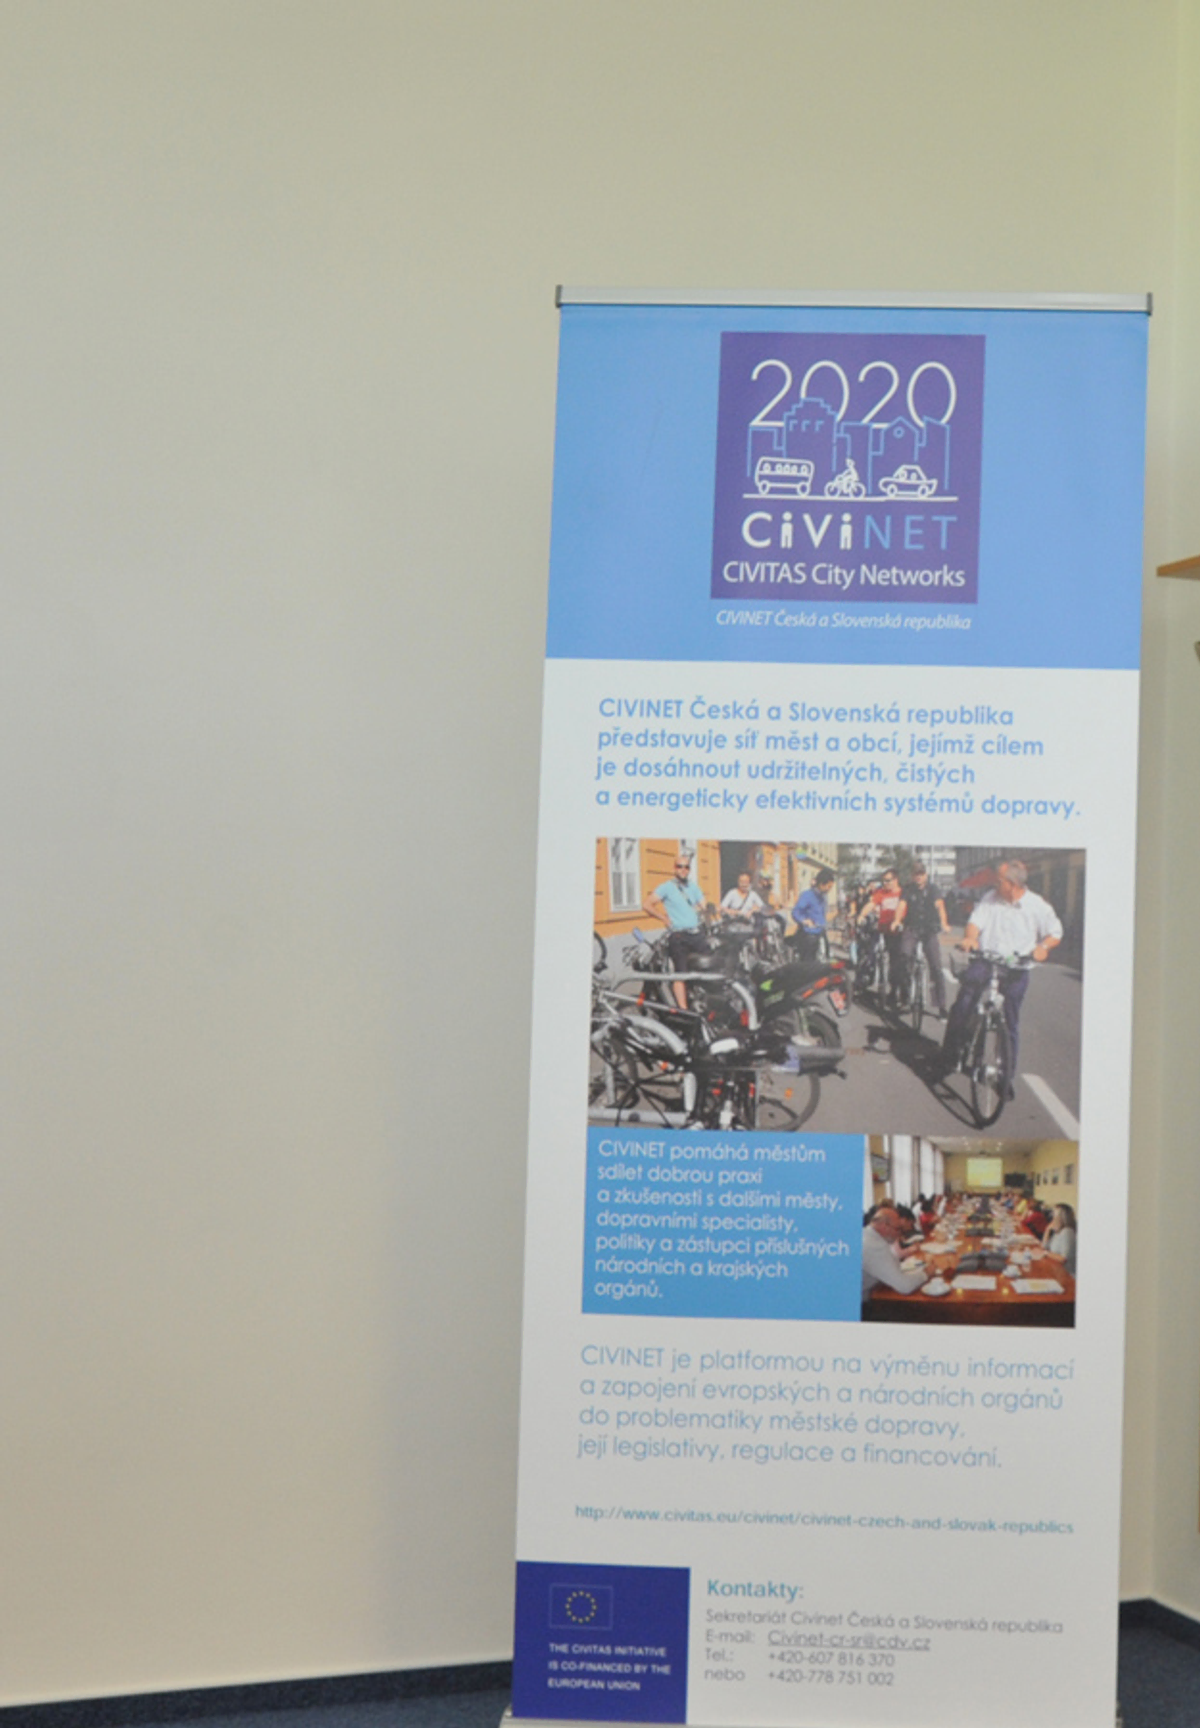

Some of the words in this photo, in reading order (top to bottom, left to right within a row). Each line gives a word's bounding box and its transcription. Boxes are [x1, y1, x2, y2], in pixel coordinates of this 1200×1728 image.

[751, 359, 956, 428] 2020
[723, 562, 805, 585] CIVITAS
[812, 563, 855, 589] City
[860, 565, 965, 587] Networks
[716, 610, 773, 625] CIVINET
[774, 609, 817, 627] Česká
[819, 616, 829, 627] a
[831, 612, 902, 628] Slovenská
[904, 614, 971, 631] republika
[599, 698, 683, 718] CIVINET
[690, 695, 759, 720] Česká
[767, 706, 781, 720] a
[789, 702, 900, 723] Slovenská
[908, 706, 1013, 727] republika
[598, 727, 727, 753] představuje
[735, 728, 759, 749] síť
[766, 731, 819, 751] měst
[826, 737, 839, 751] a
[847, 732, 901, 754] obcí,
[909, 733, 974, 758] jejímž
[982, 734, 1043, 755] cílem
[595, 756, 617, 780] je
[624, 757, 740, 778] dosáhnout
[748, 760, 887, 785] udržitelných,
[896, 763, 975, 787] čistých
[596, 791, 610, 805] a
[617, 788, 748, 812] energeticky
[756, 790, 877, 811] efektivních
[884, 792, 974, 816] systémů
[981, 795, 1080, 819] dopravy.
[599, 1140, 665, 1158] CIVINET
[670, 1143, 749, 1161] pomáhá
[754, 1144, 826, 1162] městům
[597, 1163, 642, 1180] sdílet
[648, 1165, 713, 1183] dobrou
[719, 1168, 762, 1187] praxi
[597, 1189, 609, 1202] a
[614, 1186, 702, 1205] zkušenosti
[707, 1194, 714, 1206] s
[719, 1191, 781, 1207] dalšími
[596, 1210, 697, 1229] dopravními
[595, 1234, 655, 1253] politiky
[660, 1238, 672, 1251] a
[677, 1235, 750, 1256] zástupci
[756, 1237, 849, 1258] příslušných
[595, 1256, 686, 1275] národních
[690, 1263, 703, 1276] a
[708, 1260, 788, 1280] krajských
[581, 1344, 664, 1367] CIVINET
[671, 1349, 692, 1372] je
[700, 1350, 824, 1372] platformou
[833, 1357, 861, 1373] na
[870, 1354, 959, 1378] výměnu
[968, 1357, 1074, 1380] informací
[580, 1379, 595, 1395] a
[601, 1377, 696, 1402] zapojení
[702, 1380, 830, 1405] evropských
[837, 1387, 852, 1402] a
[859, 1383, 974, 1407] národních
[981, 1387, 1063, 1413] orgánů
[579, 1406, 610, 1425] do
[616, 1408, 763, 1433] problematiky
[770, 1411, 858, 1433] městské
[577, 1434, 607, 1460] její
[613, 1436, 724, 1462] legislativy,
[732, 1442, 834, 1465] regulace
[841, 1447, 856, 1462] a
[863, 1443, 1001, 1468] financování.
[708, 1580, 804, 1603] Kontakty:
[707, 1609, 786, 1624] Sekretariát
[791, 1611, 843, 1626] Civinet
[847, 1611, 895, 1628] Česká
[899, 1618, 910, 1629] a
[914, 1615, 988, 1631] Slovenská
[992, 1620, 1063, 1634] republika
[550, 1643, 568, 1653] THE
[572, 1644, 612, 1654] CIVITAS
[615, 1646, 665, 1657] INITIATIVE
[838, 1651, 864, 1666] 816
[869, 1653, 895, 1667] 370
[548, 1661, 558, 1670] IS
[561, 1661, 632, 1673] CO-FINANCED
[634, 1664, 647, 1673] BY
[651, 1664, 670, 1674] THE
[705, 1668, 745, 1681] nebo
[839, 1671, 861, 1685] 751
[868, 1672, 894, 1686] 002
[548, 1678, 605, 1689] EUROPEAN
[607, 1681, 640, 1690] UNION
